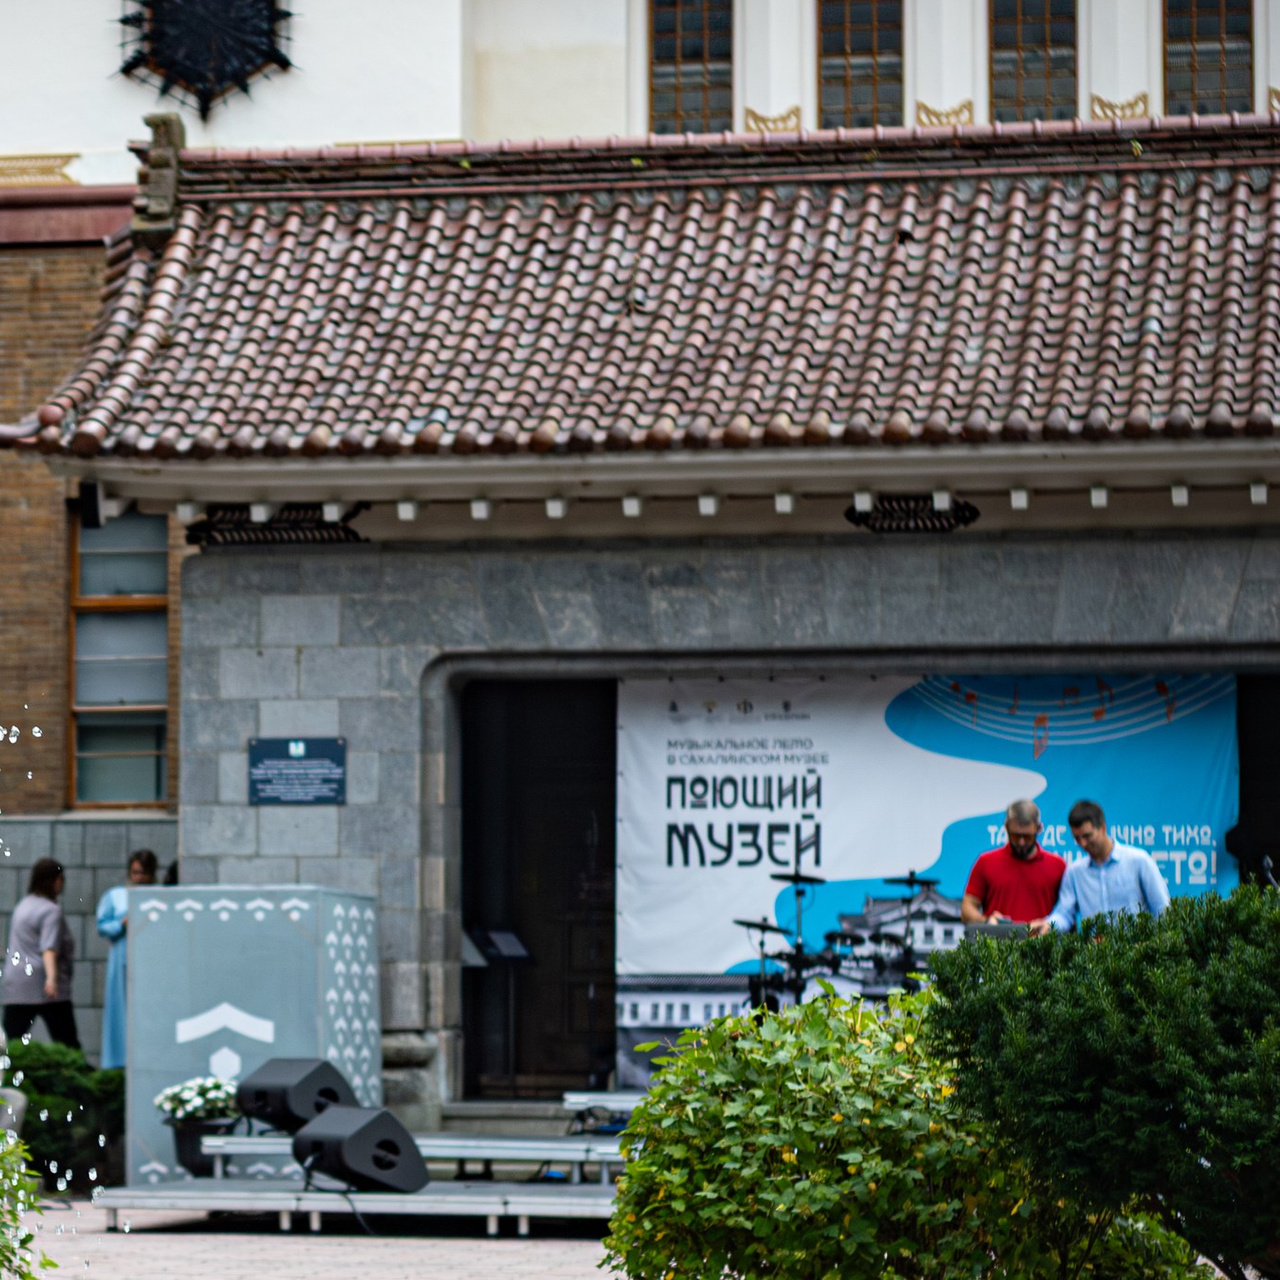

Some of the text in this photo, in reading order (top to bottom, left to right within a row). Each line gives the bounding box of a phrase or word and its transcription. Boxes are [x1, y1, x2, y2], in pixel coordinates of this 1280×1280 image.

[666, 738, 769, 750] МУЗЫКАЛЬНОЕ
[666, 752, 829, 765] В САХАЛИНСКОМ МУЗЕЕ
[666, 768, 822, 811] ПОЮЩИЙ
[666, 813, 822, 867] МУЗЕЙ
[1162, 824, 1217, 847] ТИХО,
[1151, 850, 1217, 885] ЕТО!
